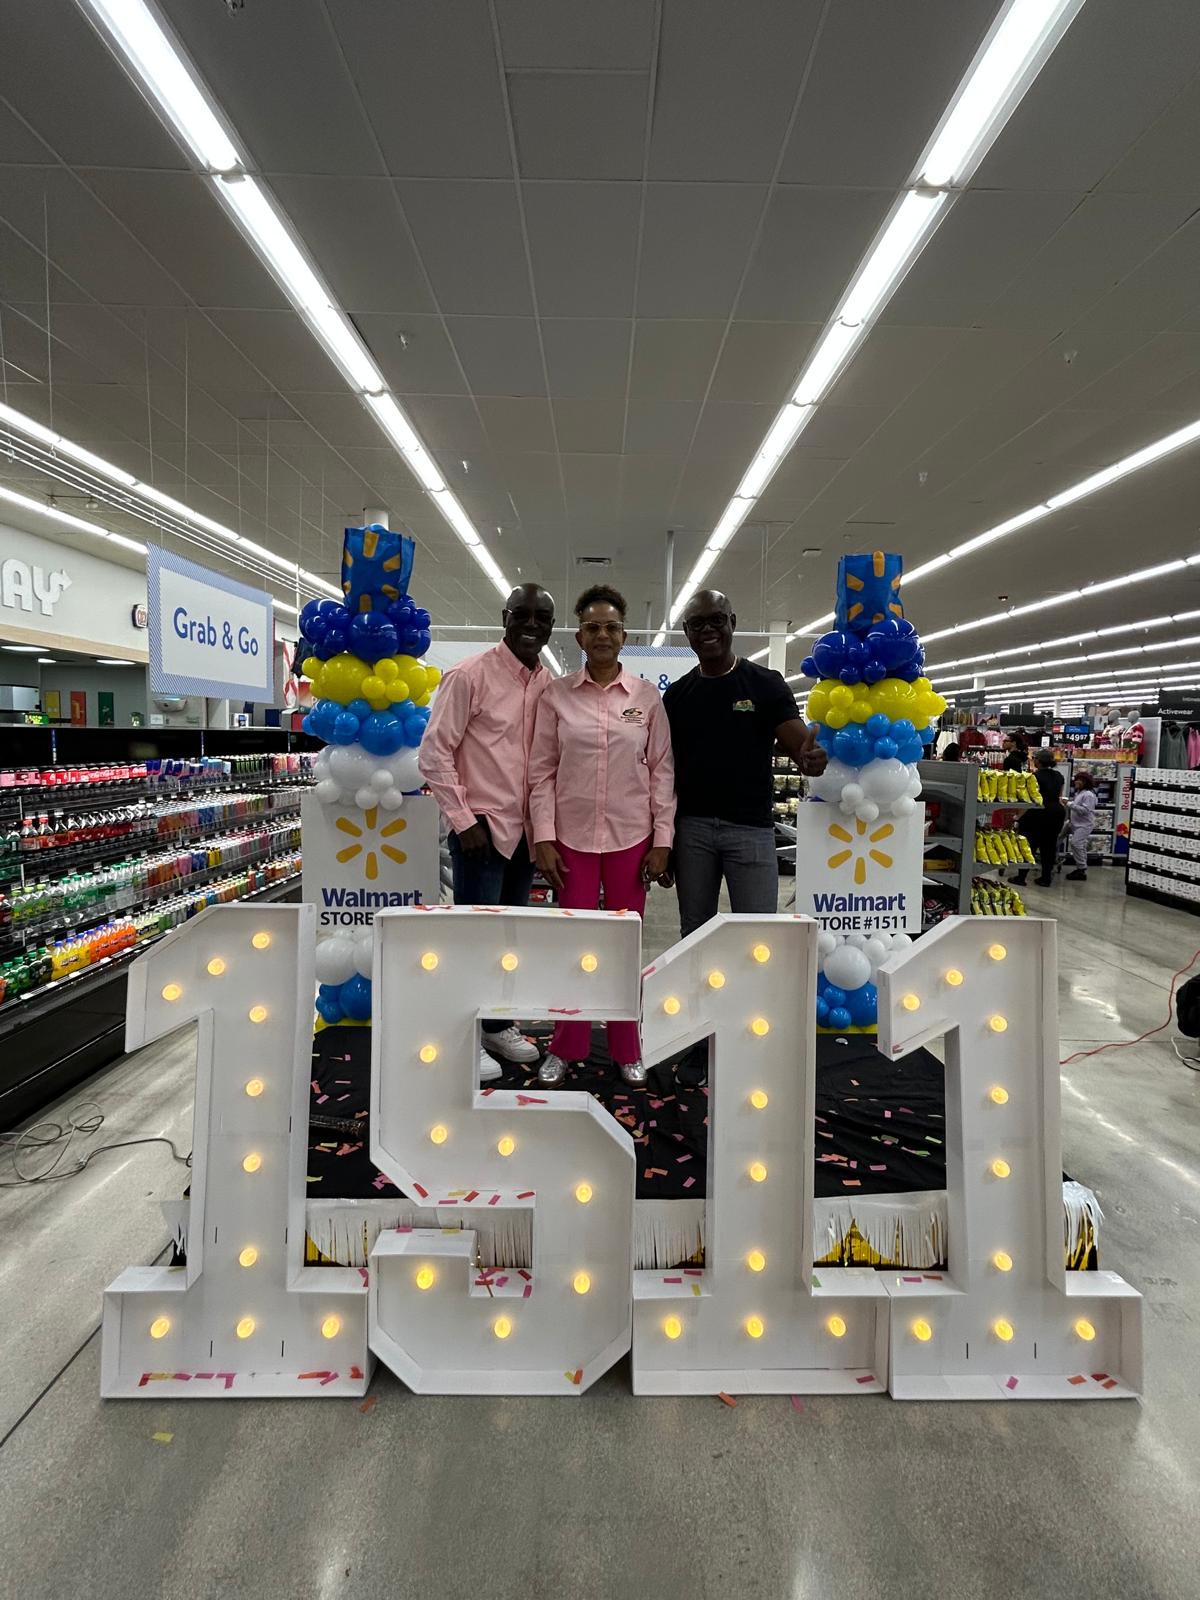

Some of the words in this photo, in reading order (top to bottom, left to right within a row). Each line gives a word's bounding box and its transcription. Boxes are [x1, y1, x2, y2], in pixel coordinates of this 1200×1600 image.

[173, 607, 217, 646] Grab
[222, 621, 233, 650] &
[238, 626, 258, 656] Go
[1123, 776, 1133, 793] Bull
[1121, 793, 1130, 810] Red
[321, 887, 422, 907] Walmart
[813, 893, 906, 912] Walmart
[320, 912, 374, 926] STORE
[814, 917, 860, 931] TORE
[863, 915, 907, 930] #1511
